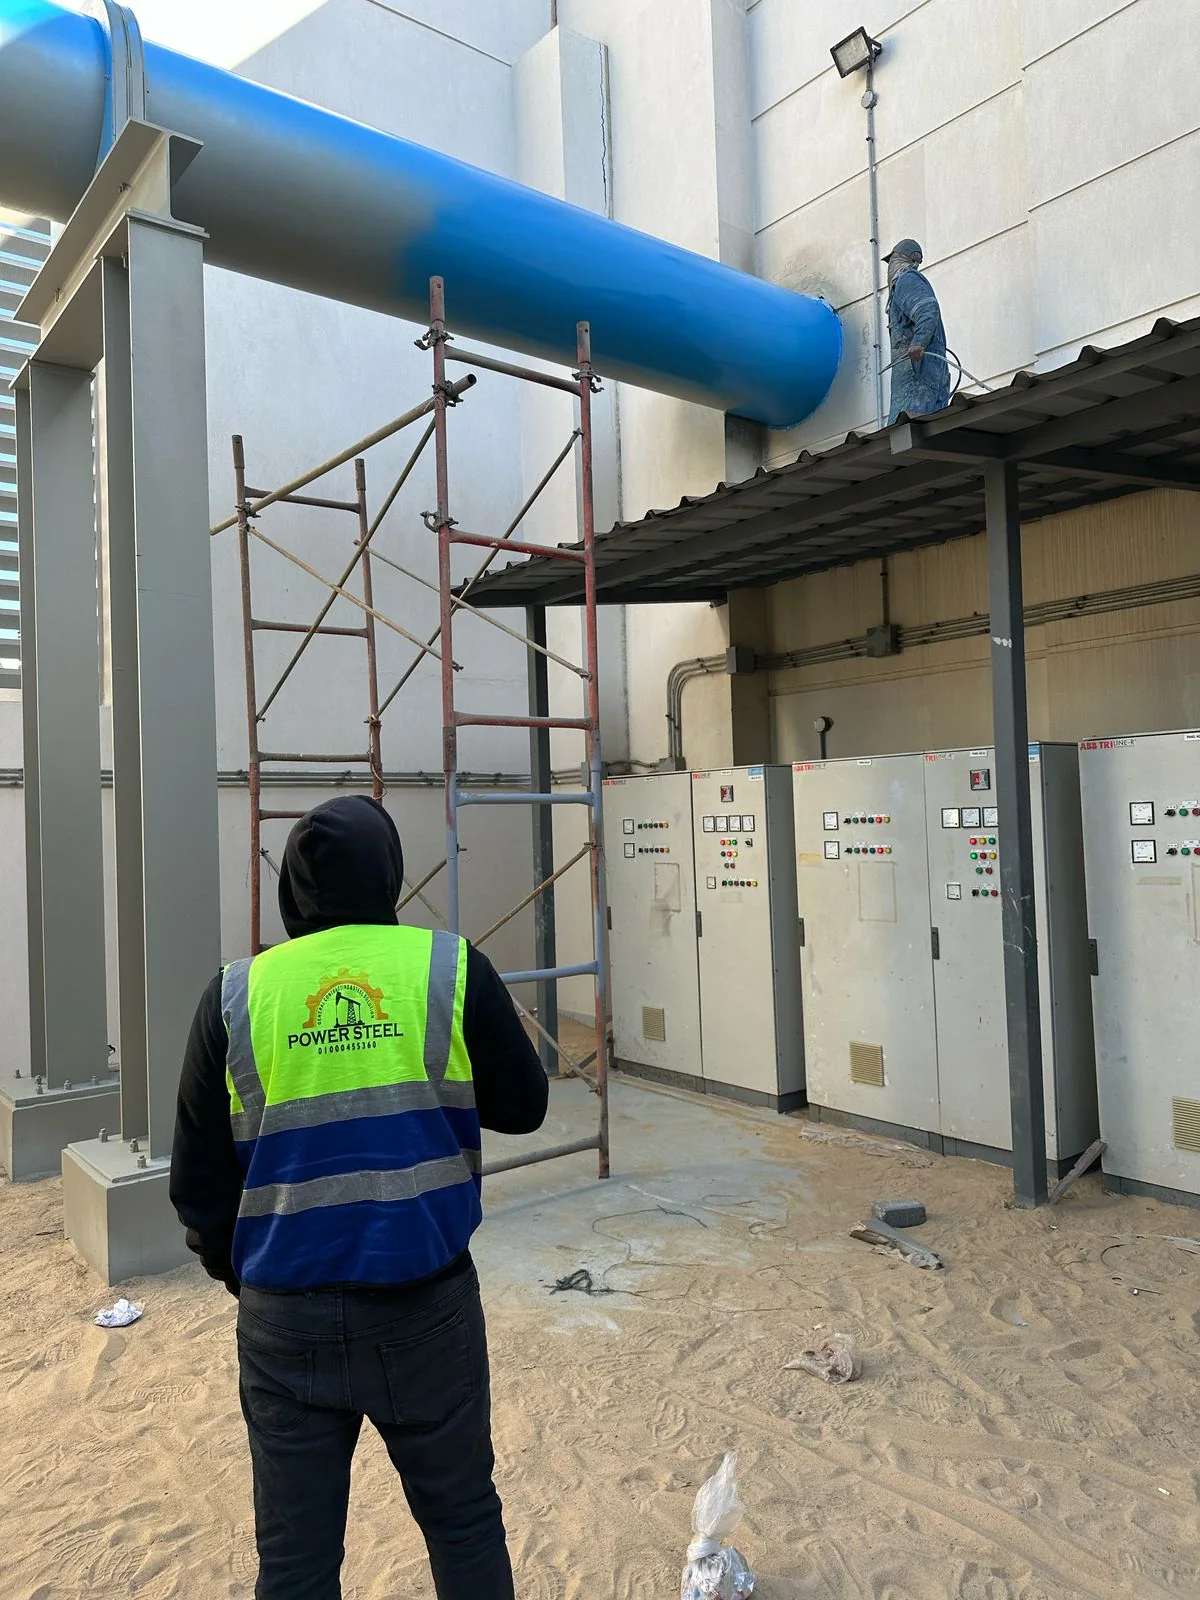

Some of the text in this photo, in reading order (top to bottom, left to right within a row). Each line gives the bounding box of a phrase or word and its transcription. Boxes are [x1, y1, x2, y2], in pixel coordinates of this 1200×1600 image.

[1080, 741, 1098, 750] ABB
[317, 1002, 326, 1026] GENERAL
[287, 1022, 404, 1049] POWER STEEL
[317, 1041, 377, 1055] 01000455360
